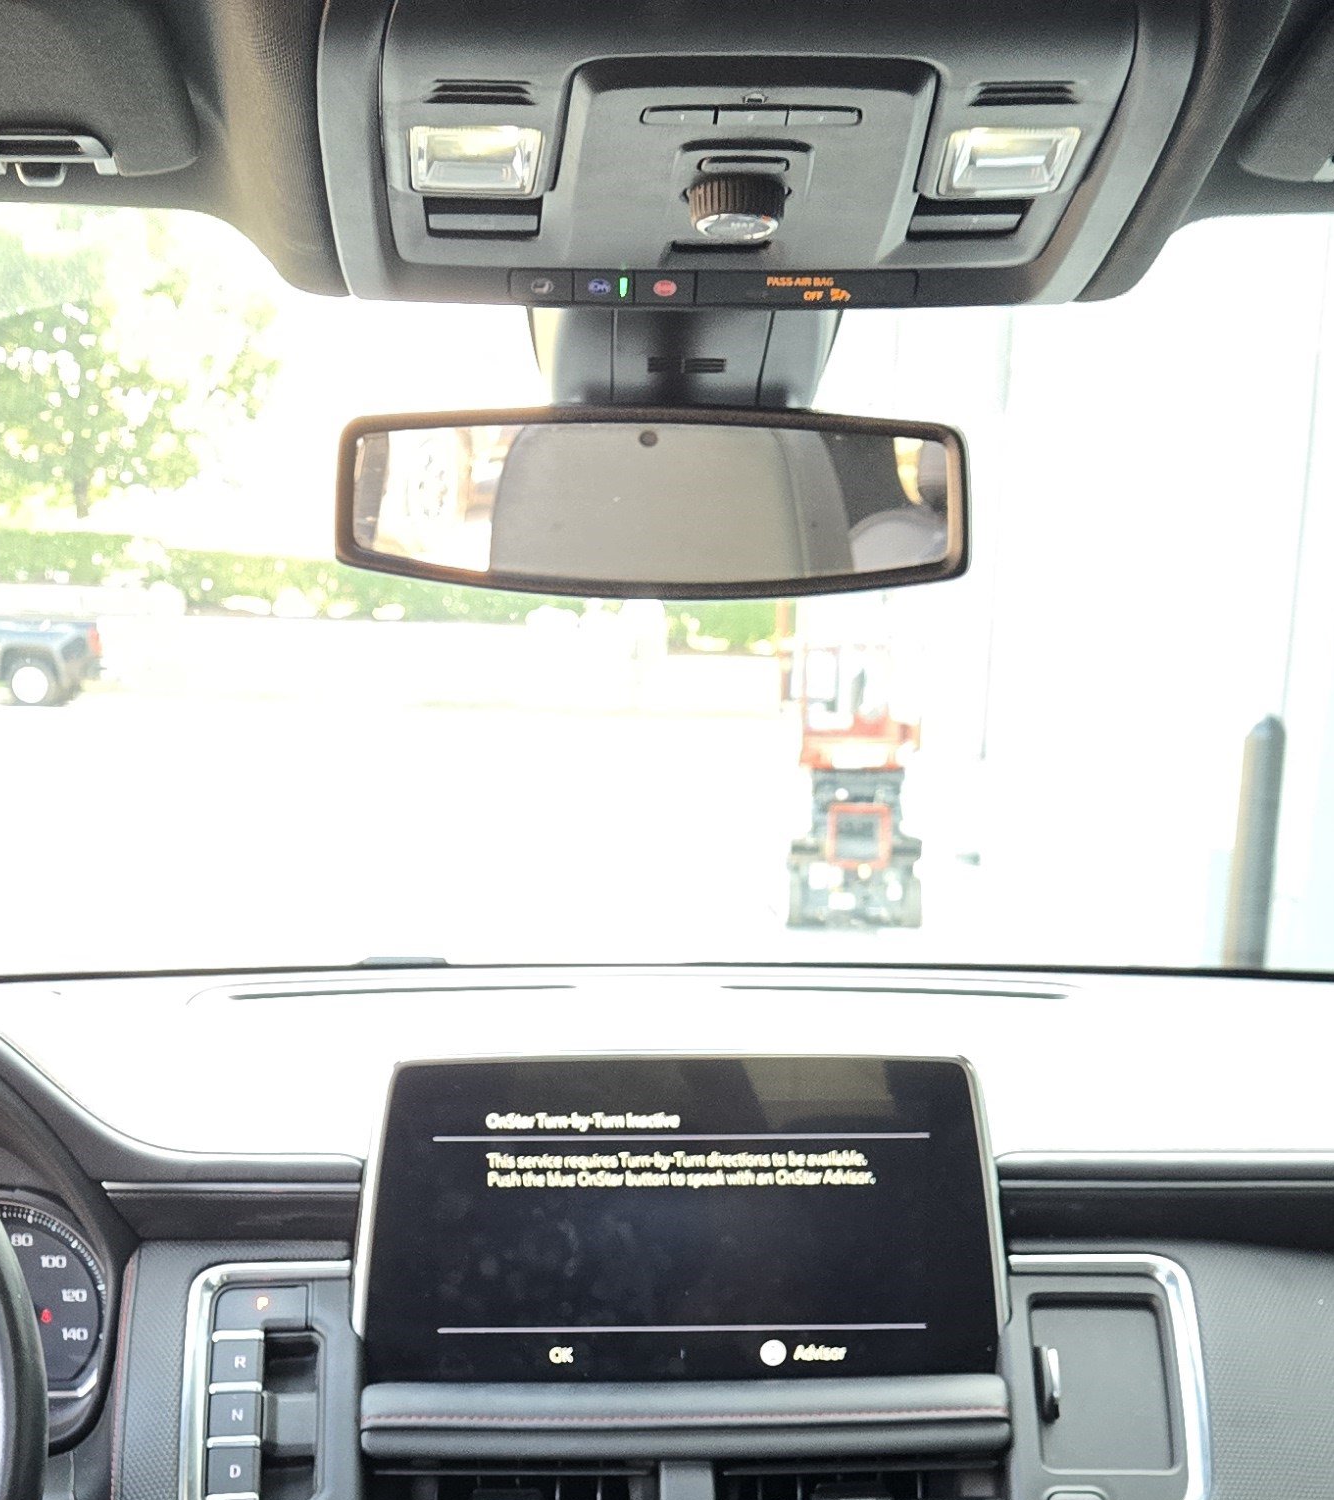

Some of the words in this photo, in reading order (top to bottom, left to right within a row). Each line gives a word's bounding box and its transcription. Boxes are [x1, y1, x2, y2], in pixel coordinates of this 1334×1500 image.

[767, 277, 793, 286] PASS
[794, 277, 811, 286] AIR
[813, 277, 834, 287] BAG
[485, 1112, 535, 1130] OnStar
[535, 1112, 625, 1132] Turn-by-Turn
[626, 1112, 681, 1130] Inactive
[486, 1152, 515, 1168] This
[517, 1153, 563, 1168] service
[563, 1153, 619, 1170] requires
[619, 1151, 705, 1171] Turn-by-Turn
[707, 1151, 771, 1168] directions
[772, 1152, 787, 1167] to
[788, 1150, 806, 1166] be
[807, 1150, 868, 1166] available.
[487, 1171, 521, 1188] Push
[523, 1171, 545, 1188] the
[547, 1170, 576, 1188] blue
[577, 1171, 624, 1188] OnStar
[625, 1170, 669, 1187] button
[670, 1171, 685, 1186] to
[687, 1170, 725, 1189] speak
[726, 1169, 755, 1186] with
[756, 1172, 774, 1186] an
[775, 1169, 823, 1186] OnStar
[823, 1168, 877, 1186] Advisor.
[11, 1233, 33, 1247] 80
[40, 1255, 67, 1268] 100
[61, 1288, 87, 1302] 120
[256, 1296, 269, 1310] P
[61, 1327, 89, 1341] 140
[549, 1346, 574, 1364] OK
[793, 1344, 847, 1362] Advisor
[234, 1355, 247, 1369] R
[231, 1408, 244, 1422] N
[229, 1464, 242, 1479] D
